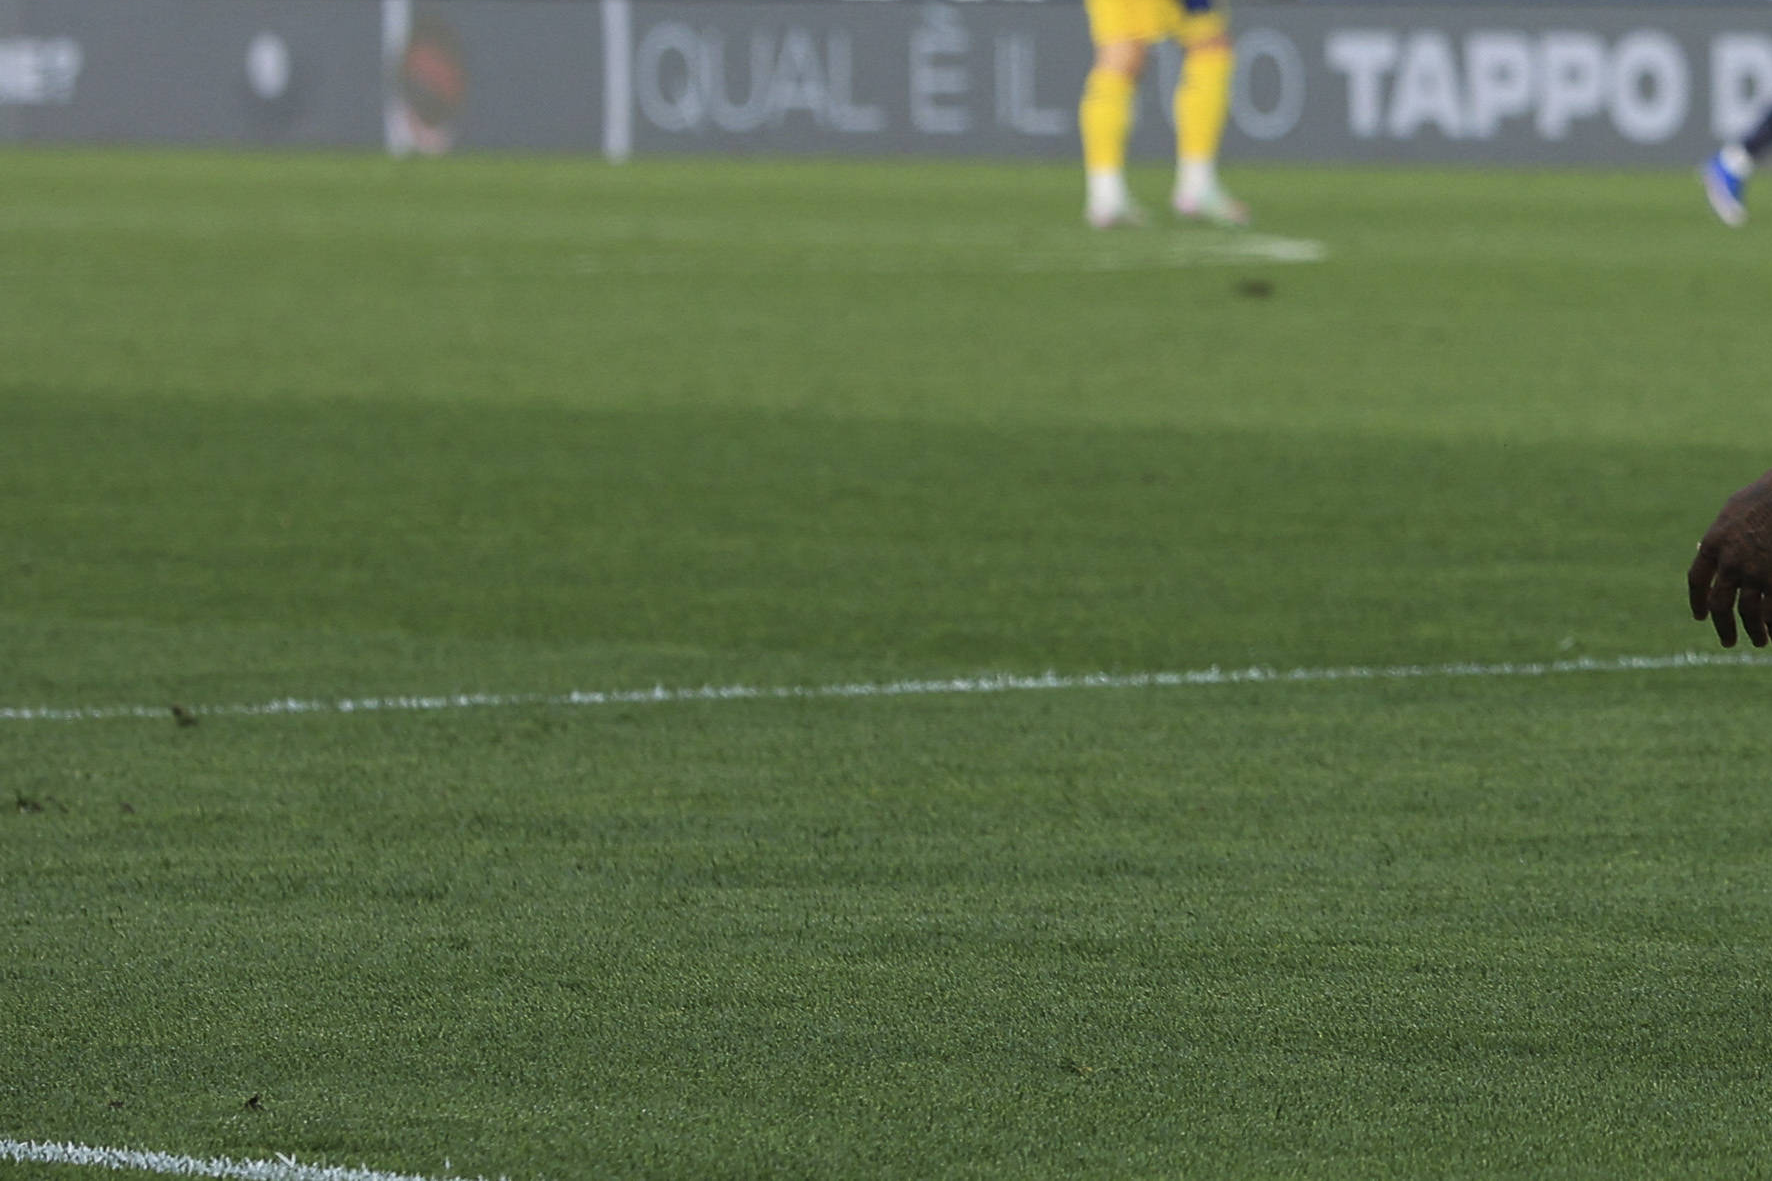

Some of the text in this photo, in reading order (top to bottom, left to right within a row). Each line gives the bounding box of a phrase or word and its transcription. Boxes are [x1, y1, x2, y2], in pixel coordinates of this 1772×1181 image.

[636, 23, 886, 135] QUAL
[994, 29, 1067, 137] IL
[1324, 27, 1689, 144] TAPPO
